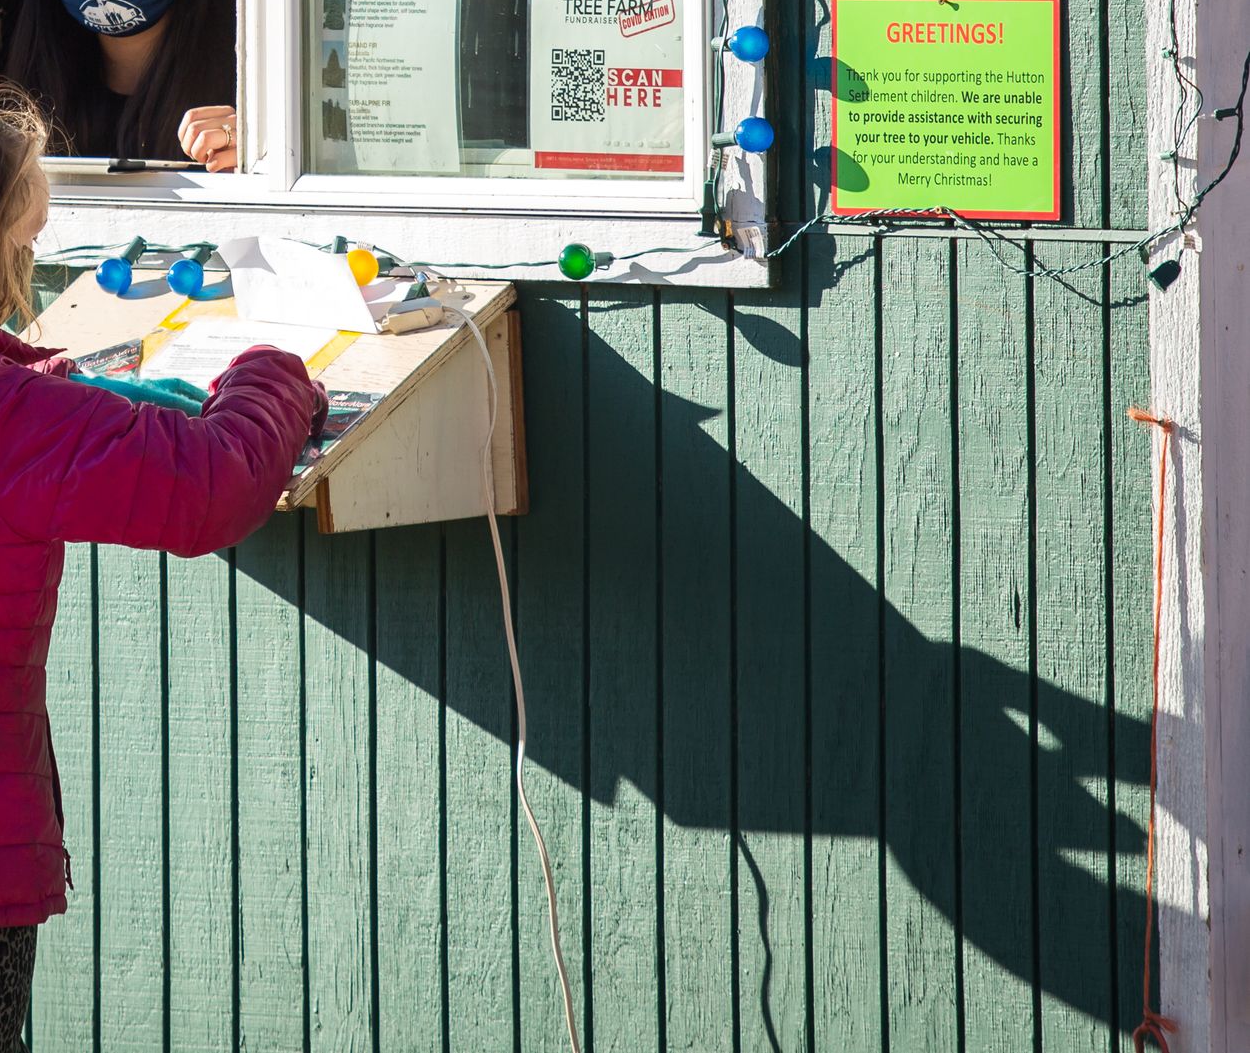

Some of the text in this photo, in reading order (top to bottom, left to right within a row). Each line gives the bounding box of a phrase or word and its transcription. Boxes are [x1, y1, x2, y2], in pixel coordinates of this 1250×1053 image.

[607, 0, 654, 16] FARM
[622, 4, 670, 30] COVID EDITION
[565, 16, 618, 25] FUNDRAISER
[886, 22, 1003, 44] GREETINGS!
[608, 68, 663, 86] SCAN
[846, 68, 1045, 86] Thank you for supporting the Hutton
[606, 88, 662, 107] HERE
[848, 89, 1043, 104] Settlement children. We are unable
[848, 110, 1043, 128] to provide assistance with securing
[855, 132, 1036, 147] your tree to your vehicle. Thanks
[853, 150, 1038, 169] for your understanding and have a
[898, 172, 992, 188] Merry Christmas!
